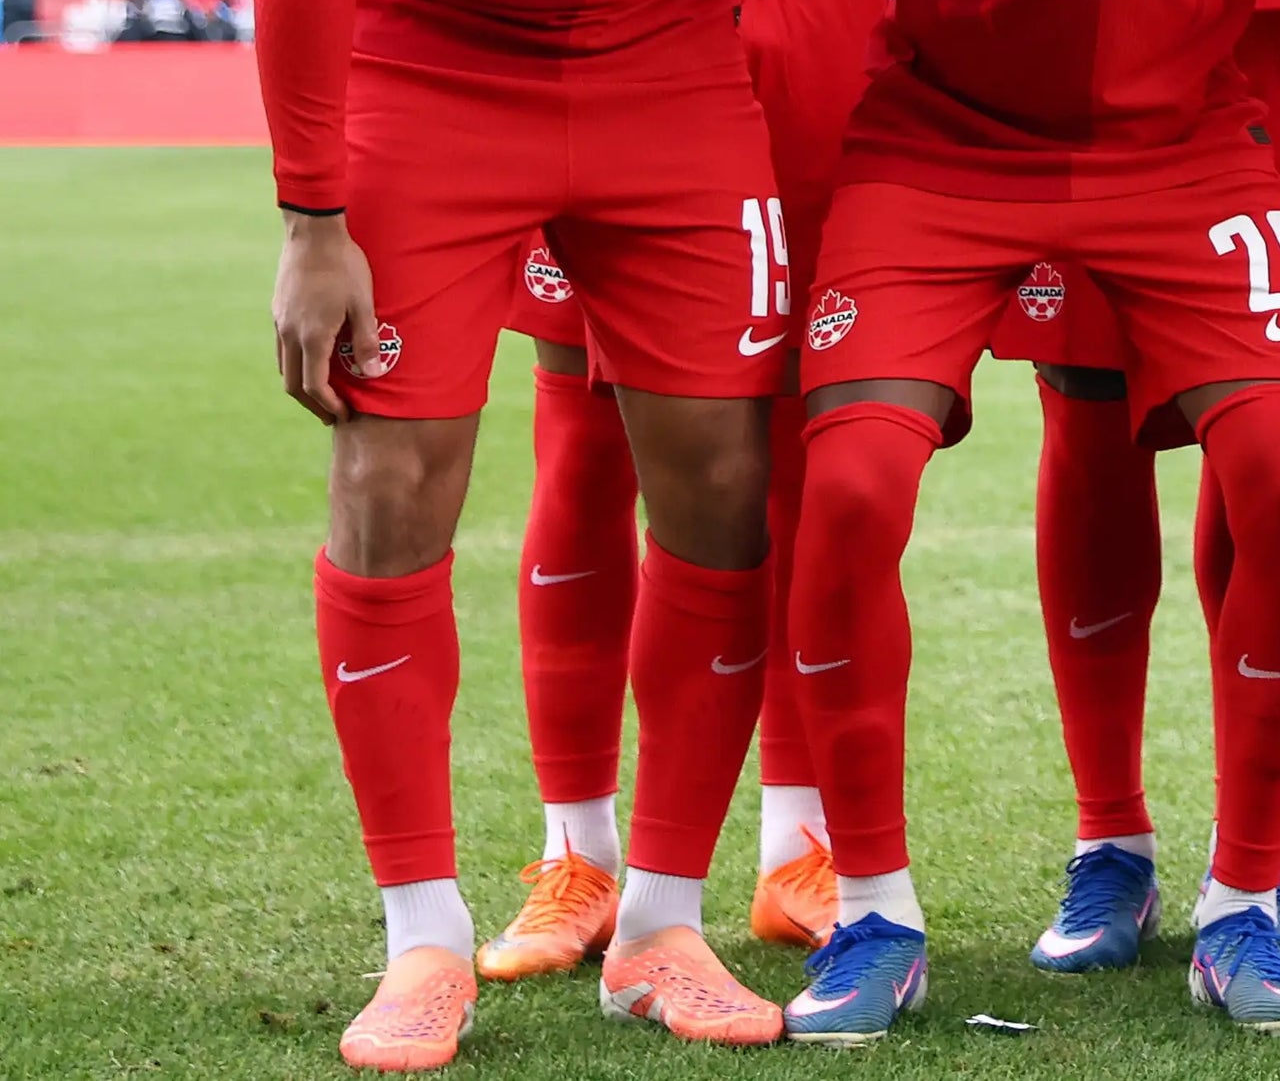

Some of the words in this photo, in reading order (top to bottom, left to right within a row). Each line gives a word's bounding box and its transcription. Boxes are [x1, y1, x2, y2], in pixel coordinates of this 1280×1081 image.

[742, 197, 791, 317] 19
[527, 264, 565, 279] CANA
[1018, 287, 1063, 298] CANADA
